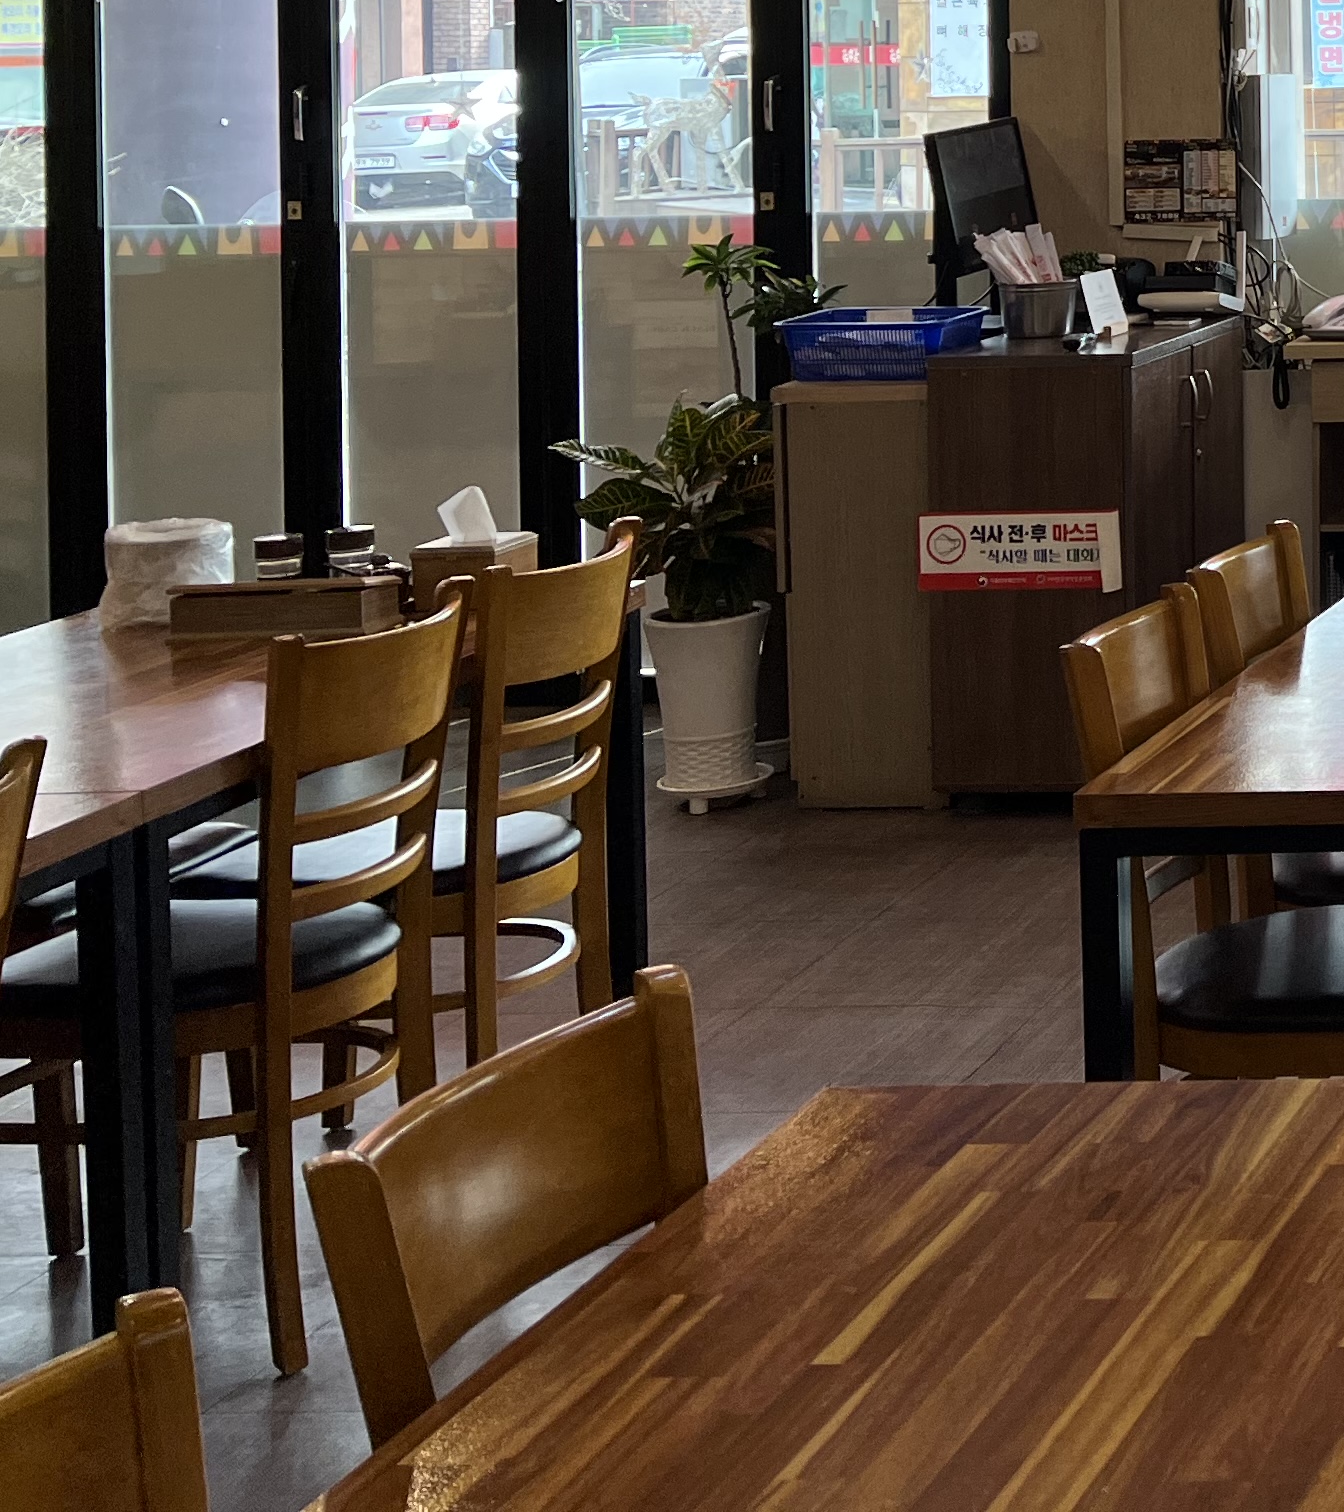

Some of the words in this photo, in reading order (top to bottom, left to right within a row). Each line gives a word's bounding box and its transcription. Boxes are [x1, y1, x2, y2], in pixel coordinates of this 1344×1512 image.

[969, 524, 1003, 544] 식사
[1008, 523, 1047, 543] 전·후
[1052, 522, 1099, 543] 마스크
[1033, 548, 1062, 563] 때는
[1066, 547, 1100, 563] 대화
